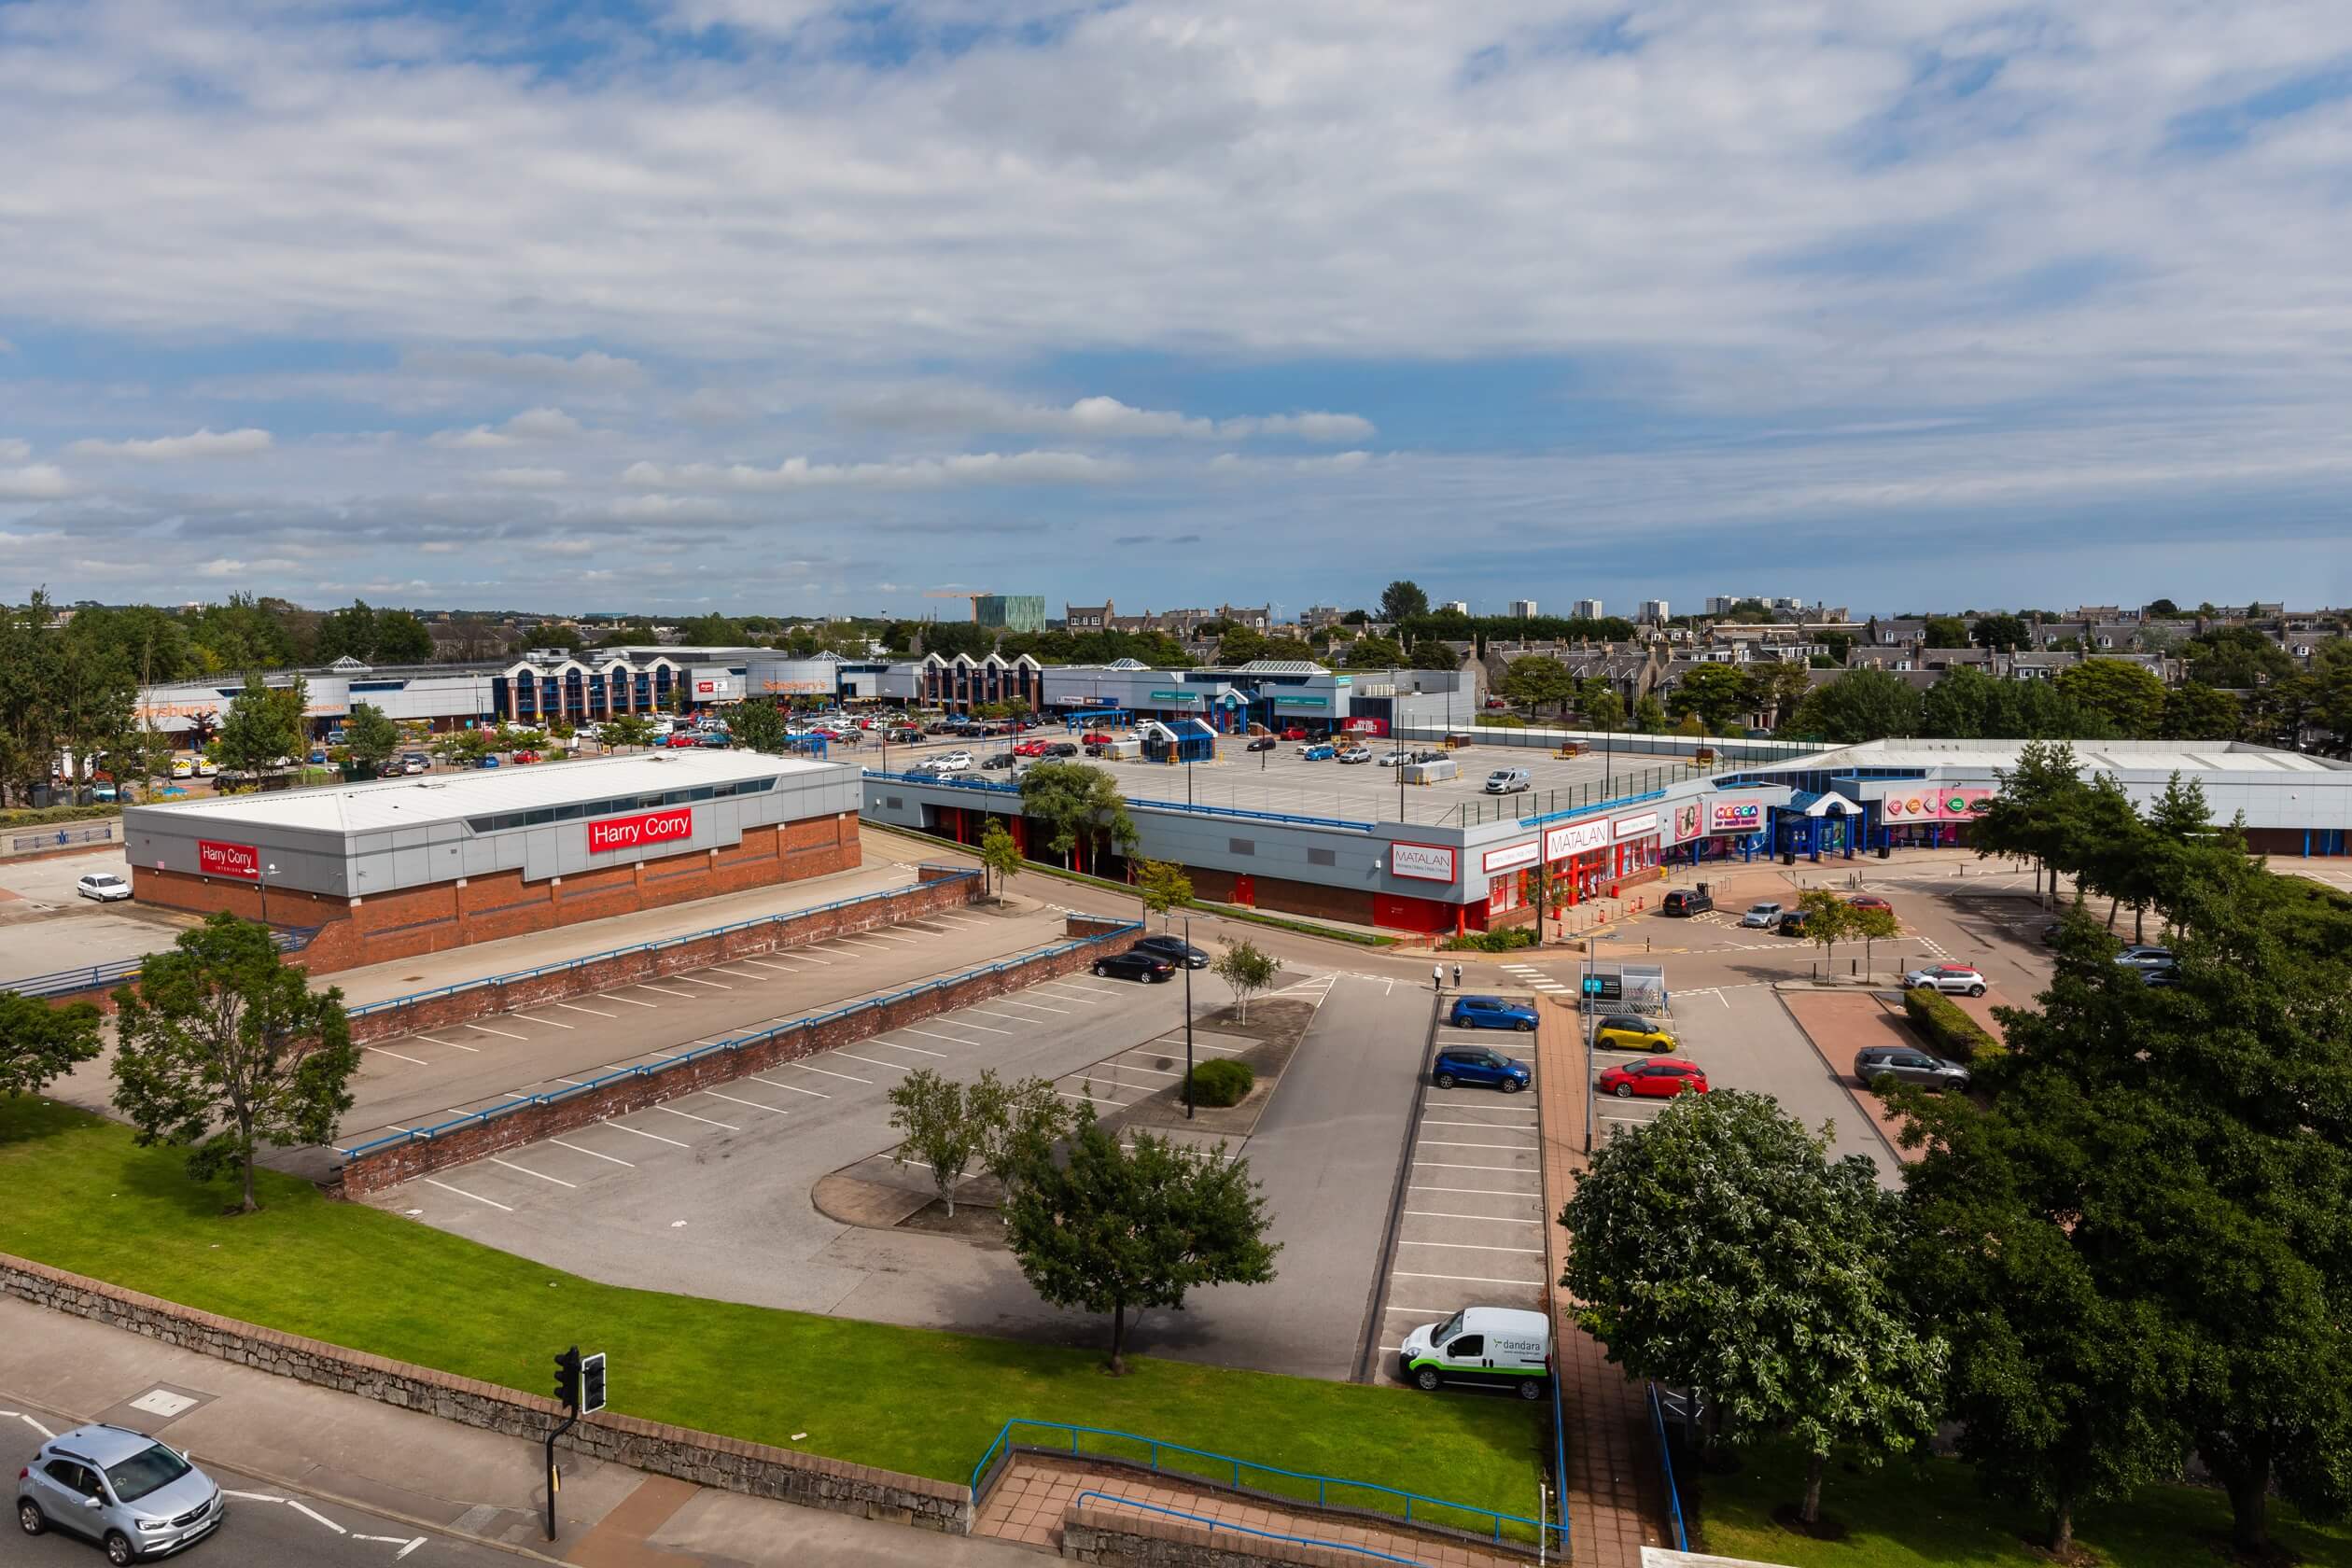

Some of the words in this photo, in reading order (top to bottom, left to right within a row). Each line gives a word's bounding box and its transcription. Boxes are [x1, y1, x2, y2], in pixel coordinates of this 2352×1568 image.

[129, 703, 218, 718] ainsbury's
[1716, 806, 1757, 818] MECCA
[595, 824, 640, 844] Harry
[645, 817, 689, 835] Corry
[1551, 826, 1605, 853] MATALAN
[203, 845, 225, 864] Harry
[228, 848, 251, 868] Corry
[1396, 850, 1449, 866] MATALAN
[1504, 1340, 1540, 1351] dandara
